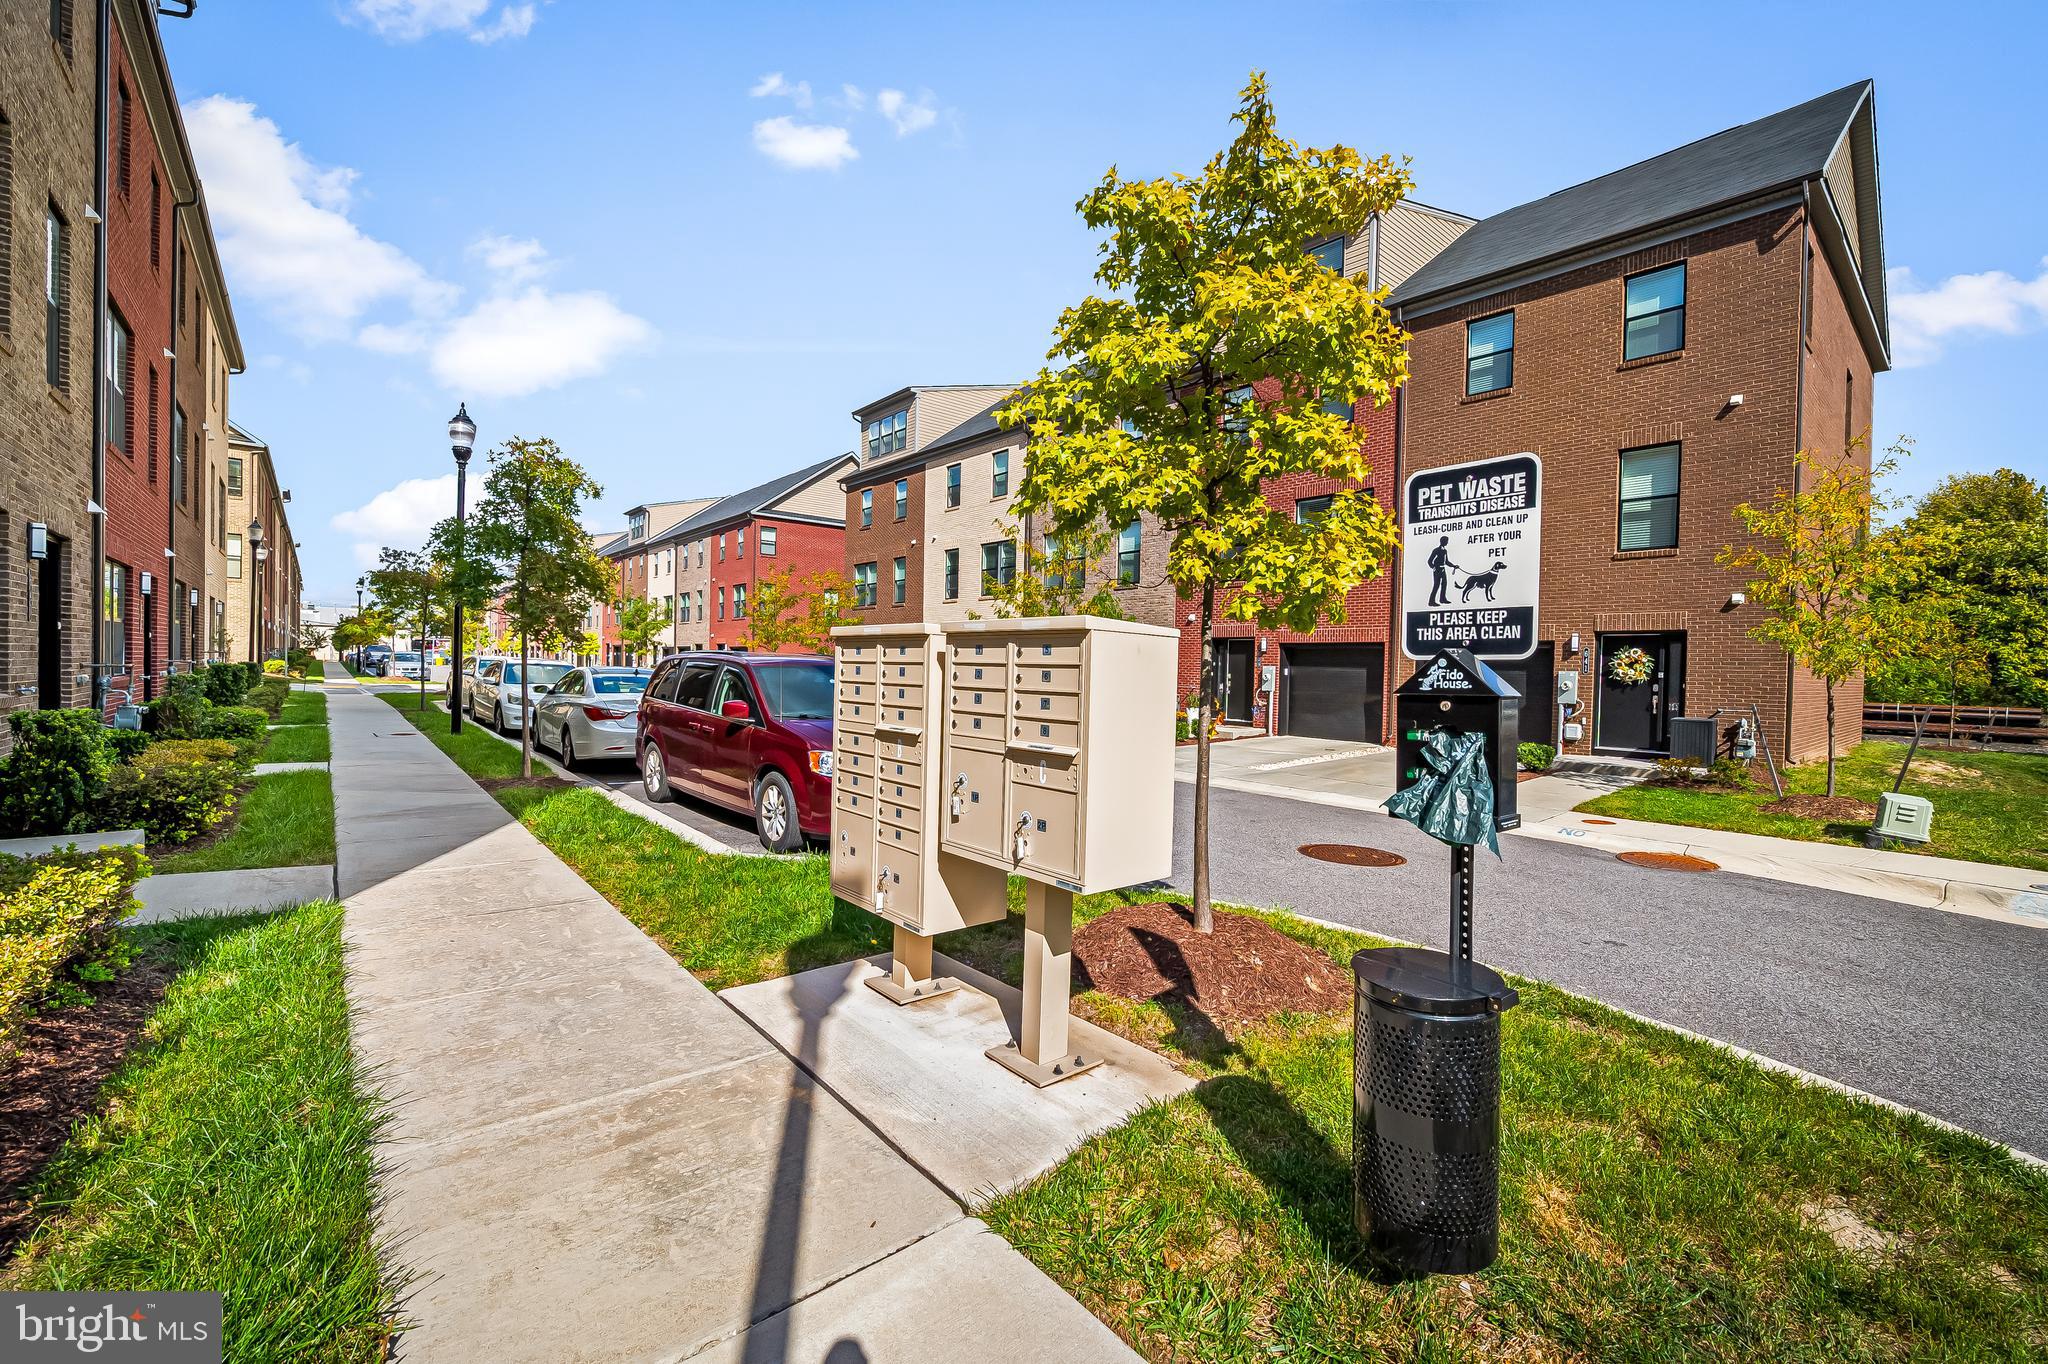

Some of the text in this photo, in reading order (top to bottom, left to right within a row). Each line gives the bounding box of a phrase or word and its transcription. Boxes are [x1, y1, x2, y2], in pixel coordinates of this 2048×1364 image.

[1418, 472, 1526, 506] PET WASTE
[1418, 494, 1526, 521] TRANSMITS DISEASE
[1413, 513, 1529, 536] LEASH-CURB AND CLEAN UP
[1467, 530, 1522, 545] AFTER YOUR
[1488, 547, 1507, 558] PET
[1429, 610, 1508, 626] PLEASE KEEP
[1417, 625, 1521, 641] THIS AREA CLEAN
[1438, 668, 1464, 680] Fido
